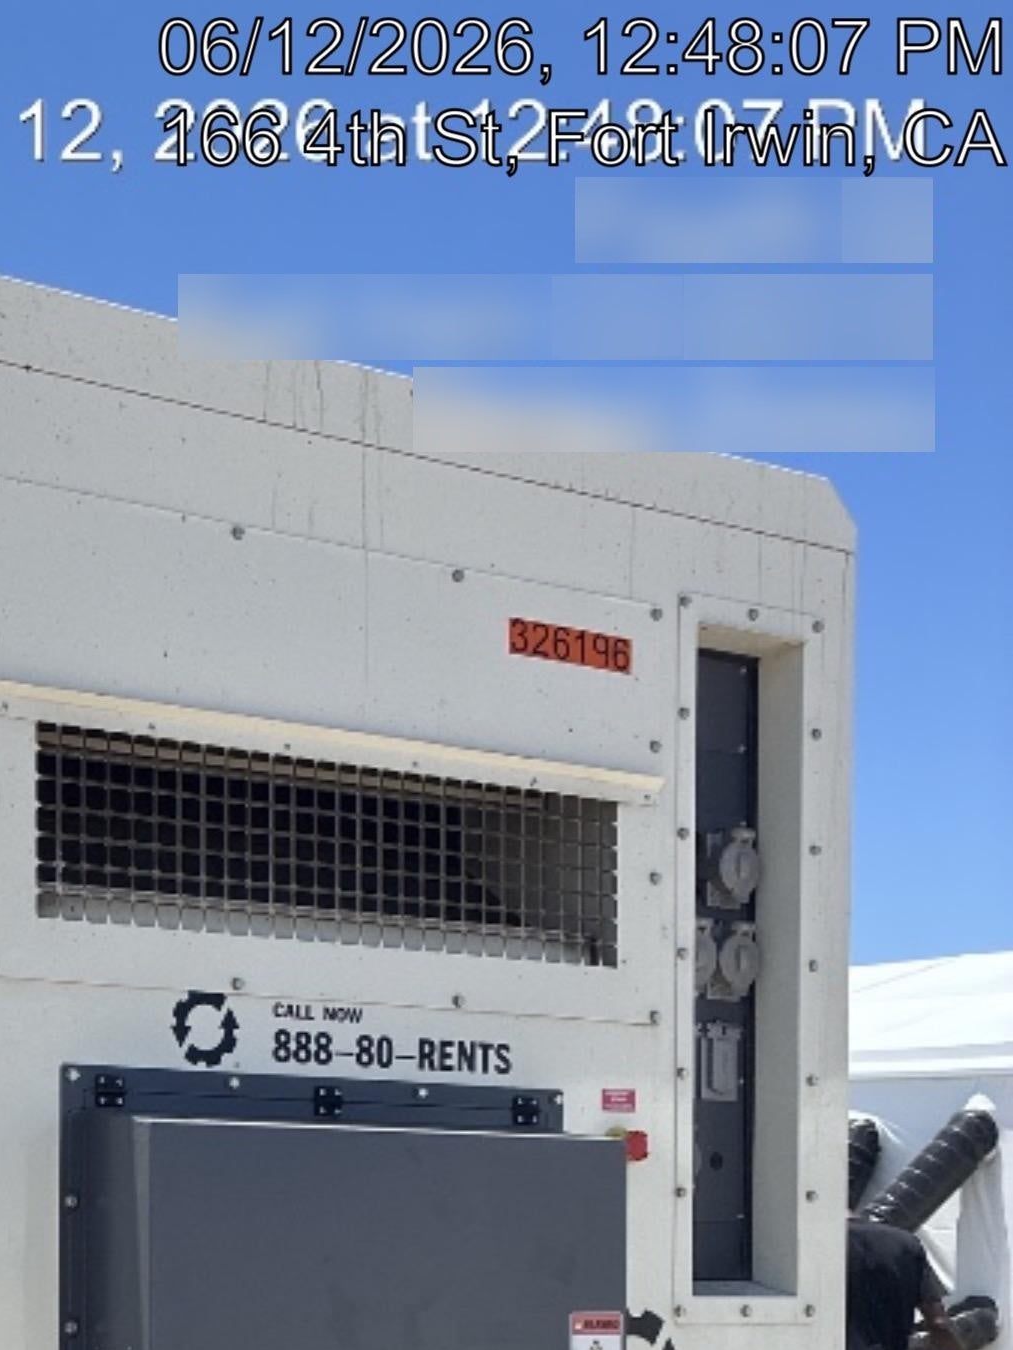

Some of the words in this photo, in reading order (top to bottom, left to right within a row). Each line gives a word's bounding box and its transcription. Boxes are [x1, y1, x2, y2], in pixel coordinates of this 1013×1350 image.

[509, 618, 631, 673] 326196
[273, 1002, 315, 1021] CALL
[322, 1007, 363, 1024] NOW
[272, 1028, 512, 1076] 888-80-RENTS
